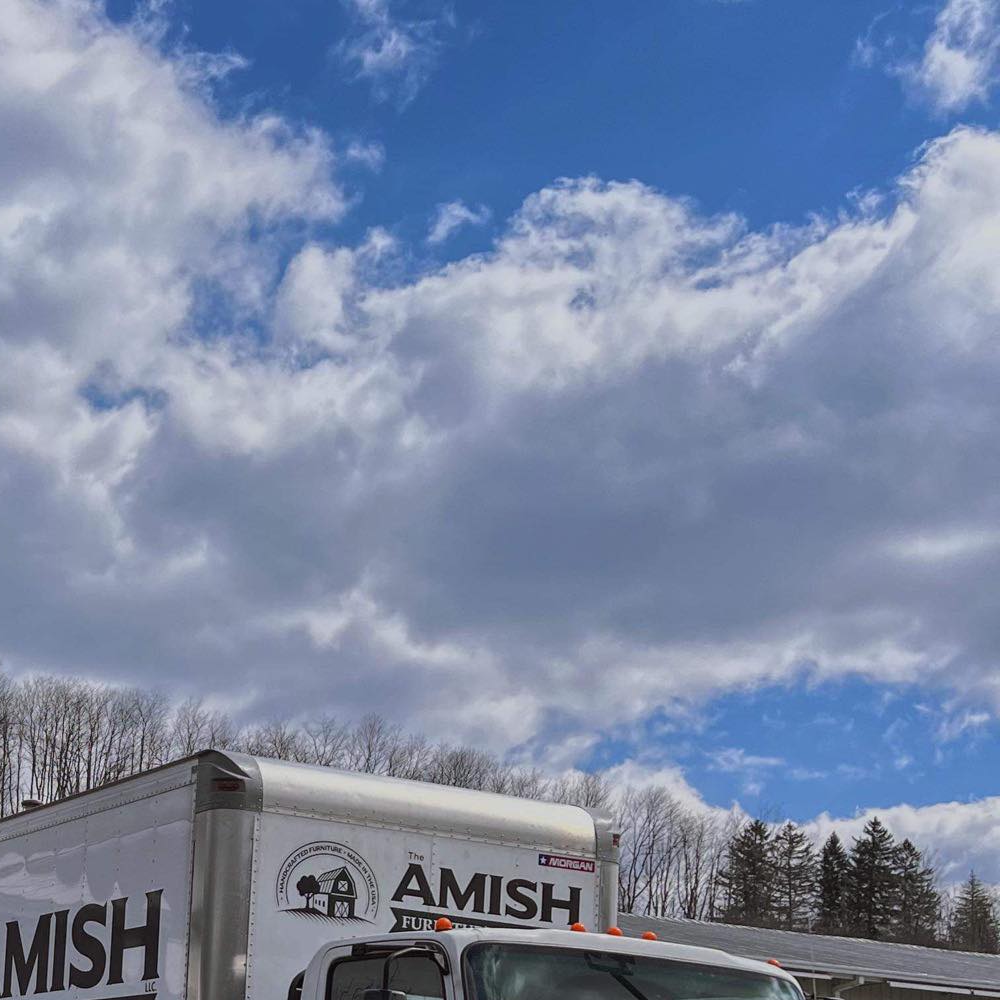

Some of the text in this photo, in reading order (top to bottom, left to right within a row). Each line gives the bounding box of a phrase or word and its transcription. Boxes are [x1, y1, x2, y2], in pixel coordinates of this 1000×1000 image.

[408, 851, 424, 861] The
[280, 849, 309, 893] HANDCRAFTED
[309, 845, 342, 854] FURNITURE
[347, 852, 362, 867] MADE
[361, 865, 368, 874] IN
[365, 873, 375, 888] THE
[549, 857, 593, 871] MORGAN
[390, 863, 582, 926] AMISH
[144, 981, 157, 992] LLC
